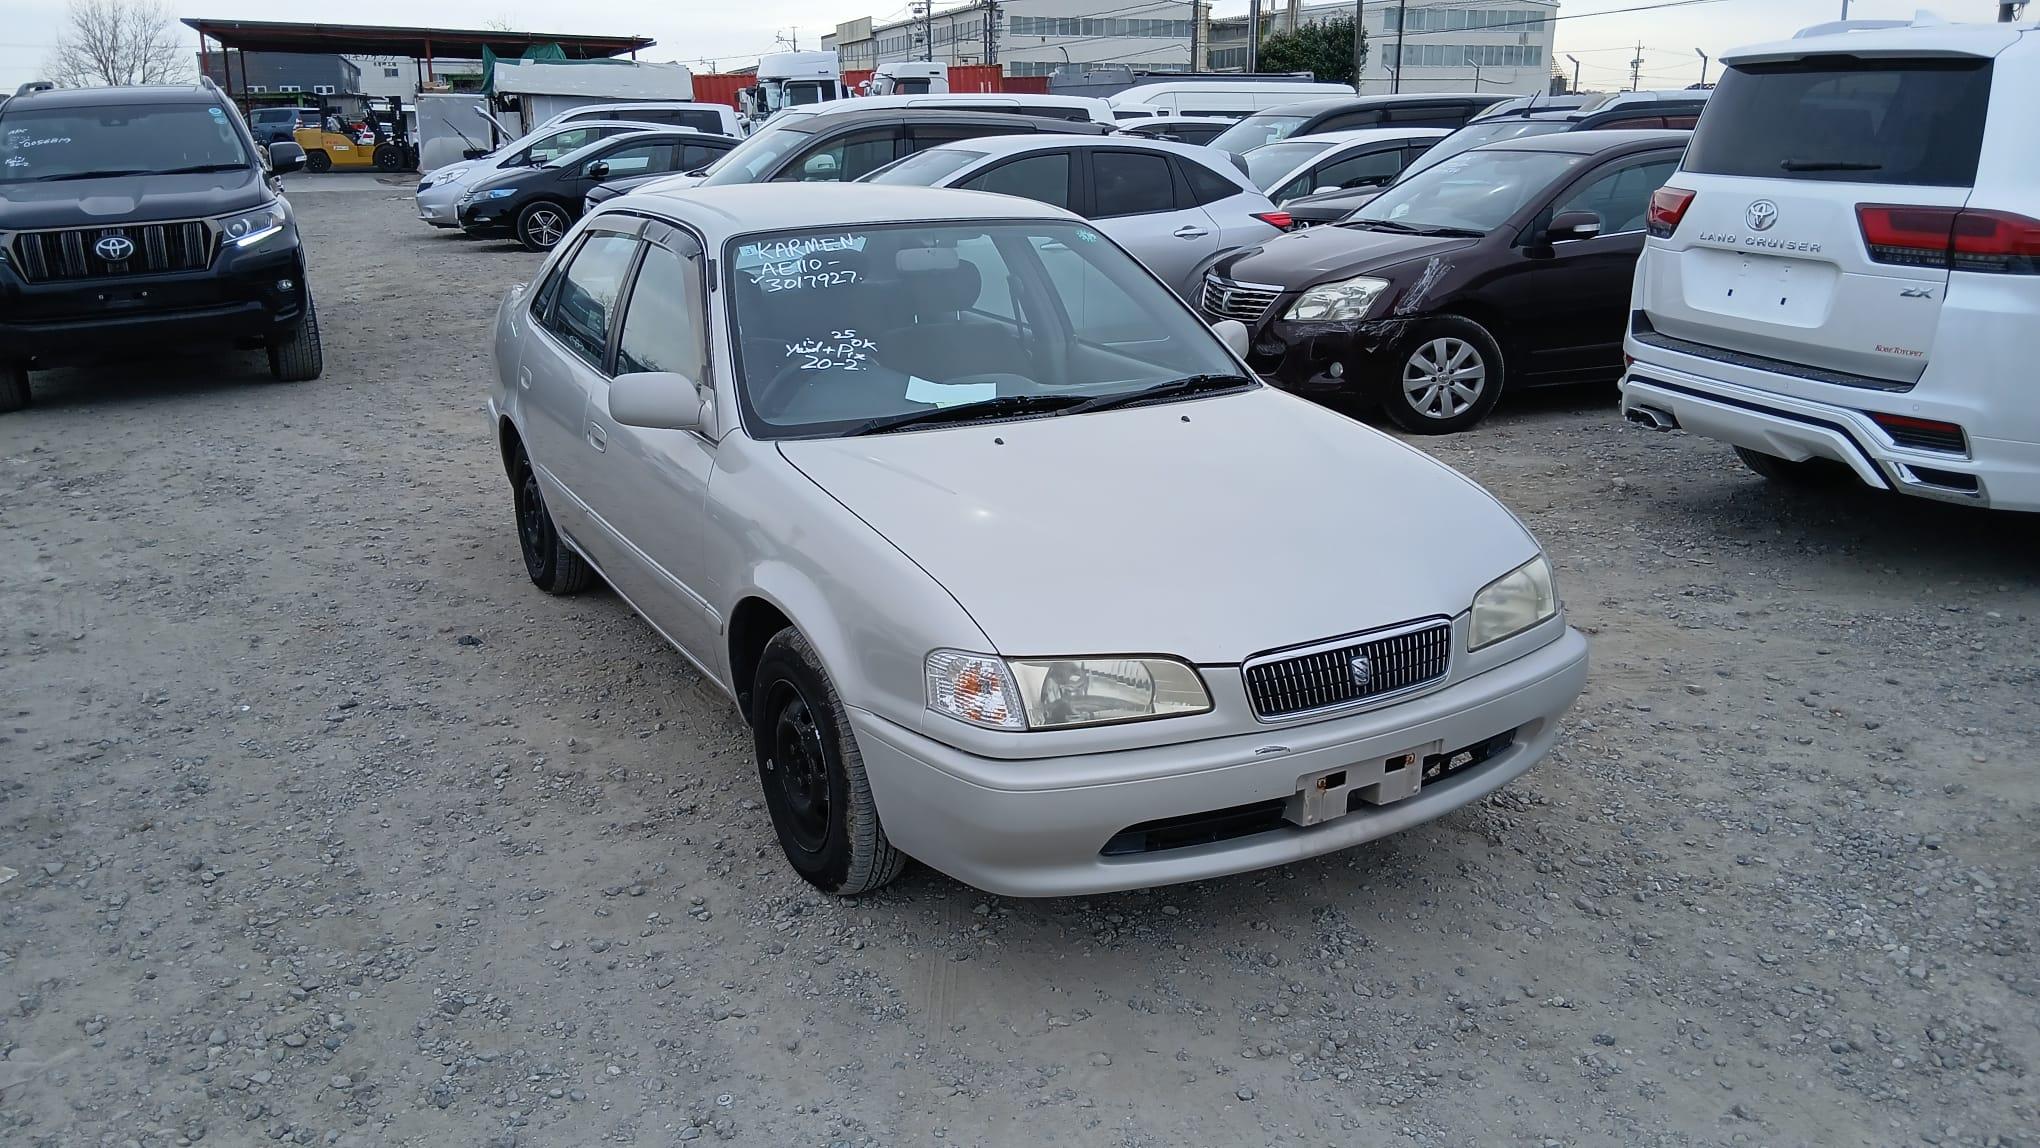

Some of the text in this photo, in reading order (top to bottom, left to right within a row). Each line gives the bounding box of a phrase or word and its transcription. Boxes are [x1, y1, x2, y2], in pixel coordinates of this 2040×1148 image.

[757, 233, 853, 259] KARMEN
[1699, 231, 1822, 253] LAND CRUISER
[1900, 287, 1934, 299] ZX
[831, 329, 857, 339] 25
